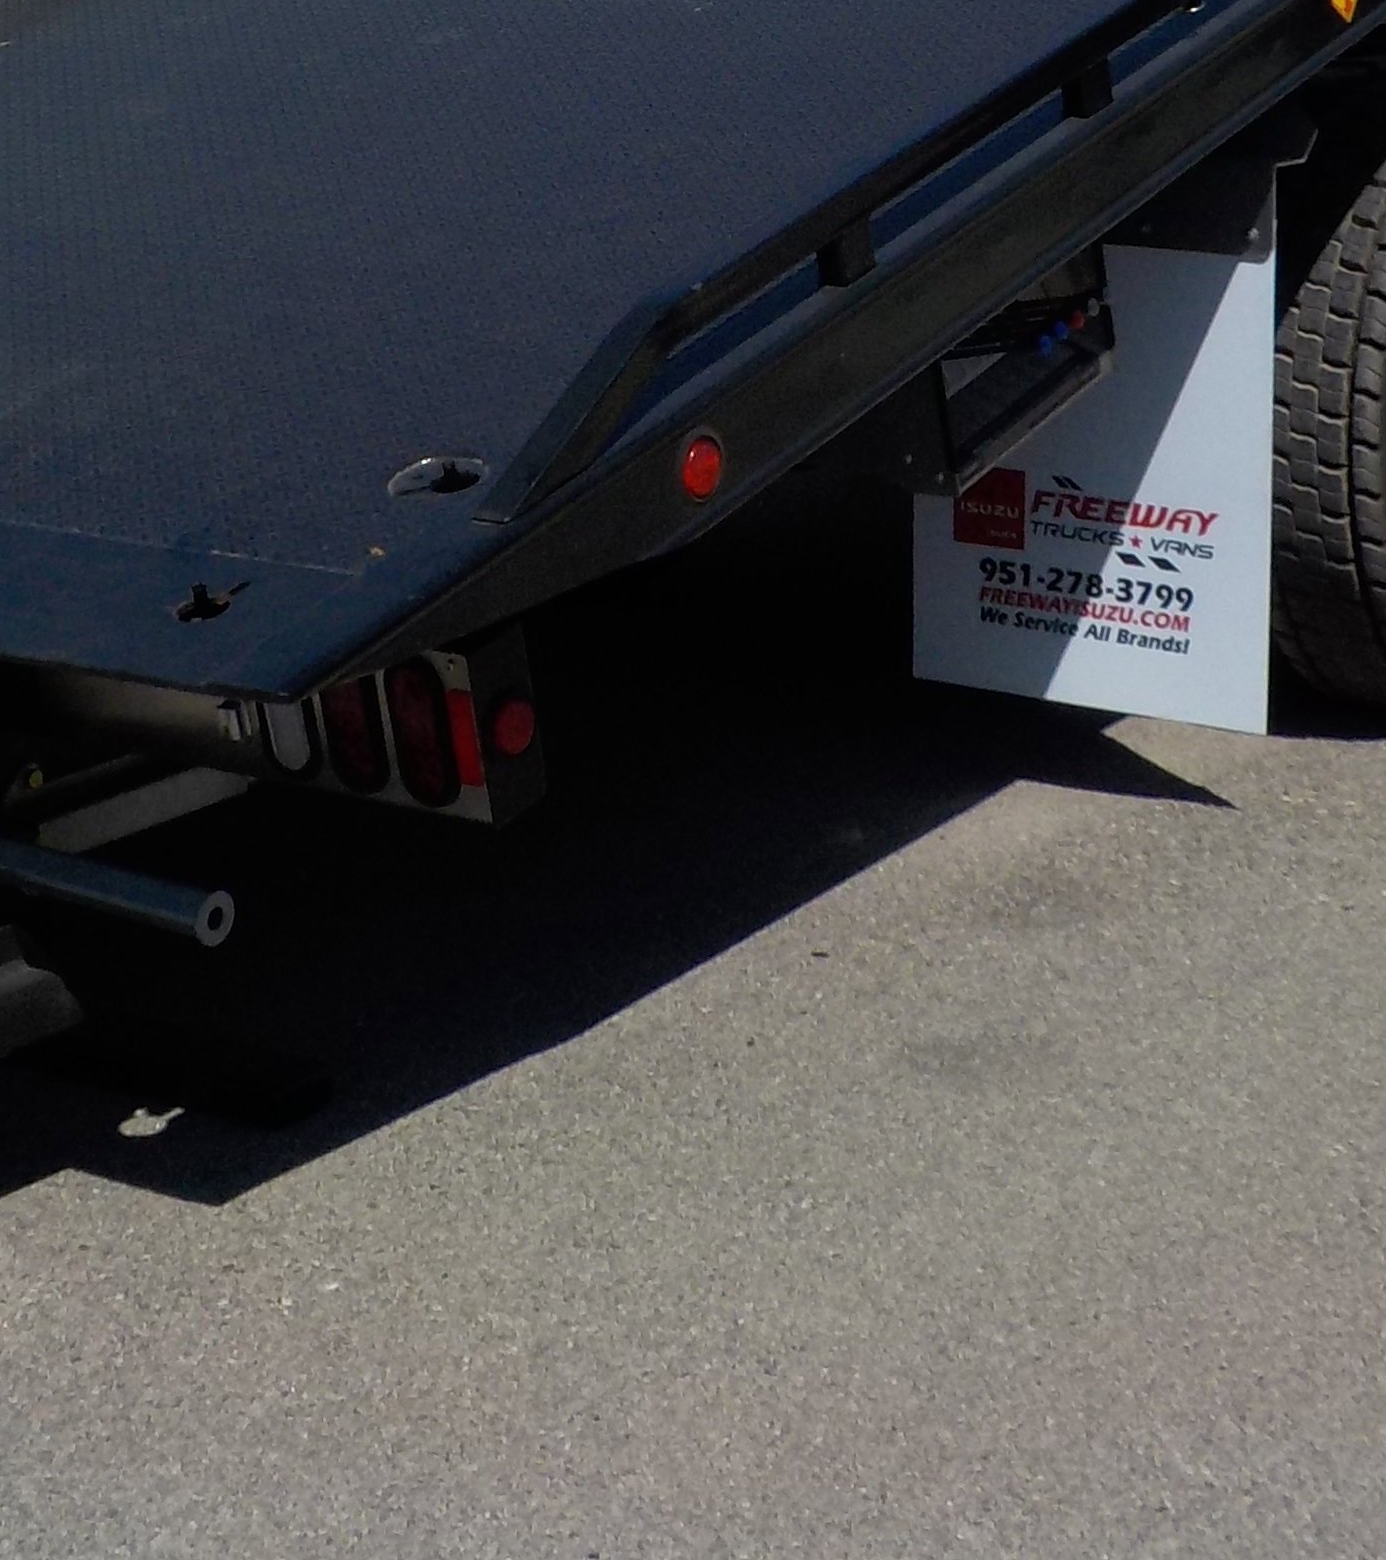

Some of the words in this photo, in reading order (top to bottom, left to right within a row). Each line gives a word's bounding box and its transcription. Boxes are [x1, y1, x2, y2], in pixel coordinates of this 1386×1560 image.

[960, 501, 1019, 519] ISUZU
[1030, 489, 1219, 536] FREEWAY
[1030, 520, 1125, 547] TRUCKS
[1150, 536, 1215, 560] VANS
[979, 557, 1194, 612] 951-278-3799
[979, 586, 1190, 633] FREEWAYISUZU.COM
[980, 606, 1009, 625] We
[1013, 611, 1079, 636] Service
[1083, 621, 1111, 642] All
[1116, 628, 1190, 655] Brands!
